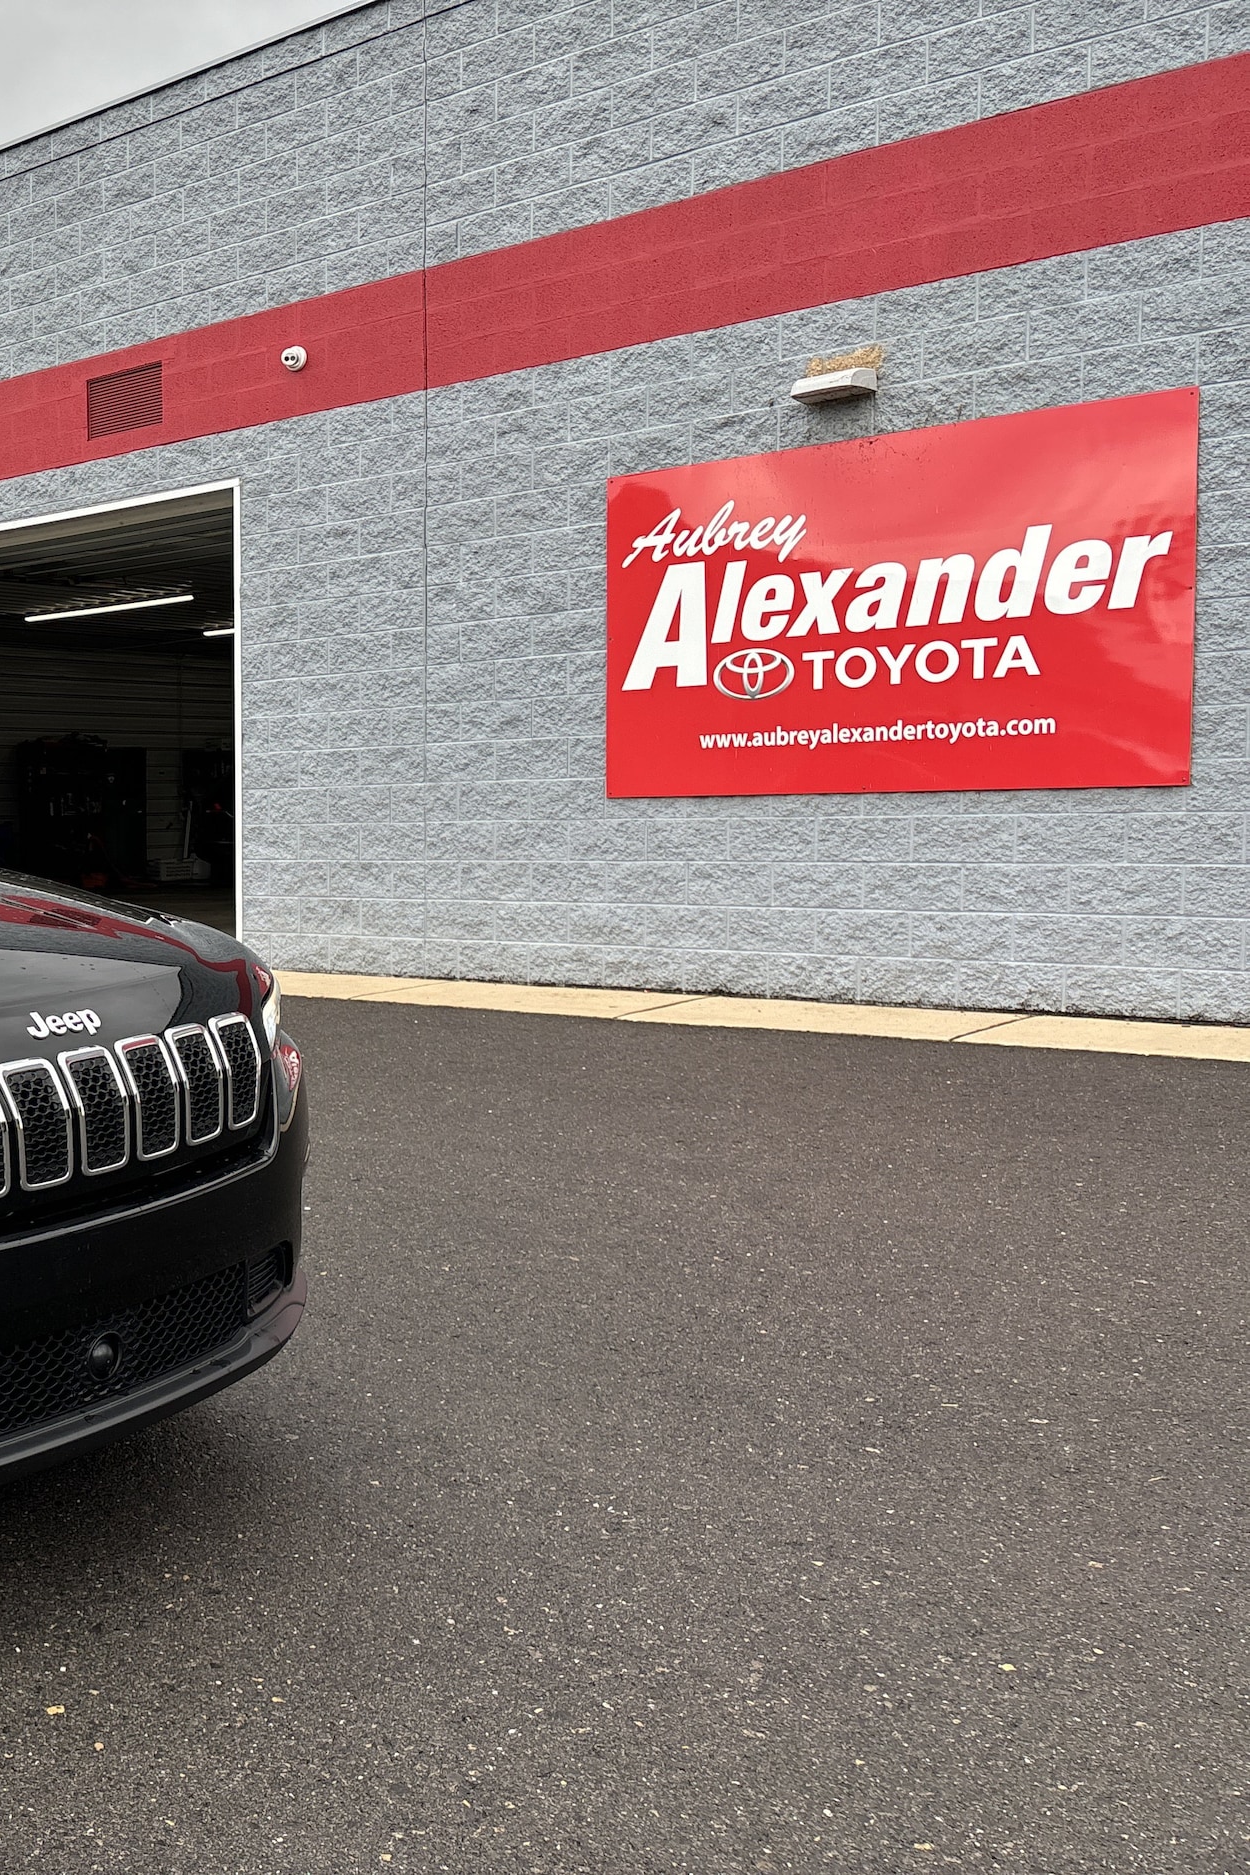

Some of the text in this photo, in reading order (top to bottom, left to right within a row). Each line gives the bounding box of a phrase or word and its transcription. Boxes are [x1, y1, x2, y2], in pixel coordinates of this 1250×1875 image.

[621, 499, 808, 570] Aubrey
[621, 522, 1174, 692] Alexander
[801, 635, 1042, 691] TOYOTA
[698, 714, 1057, 750] www.aubreyalexandertoyota.com
[26, 1008, 102, 1040] Jeep
